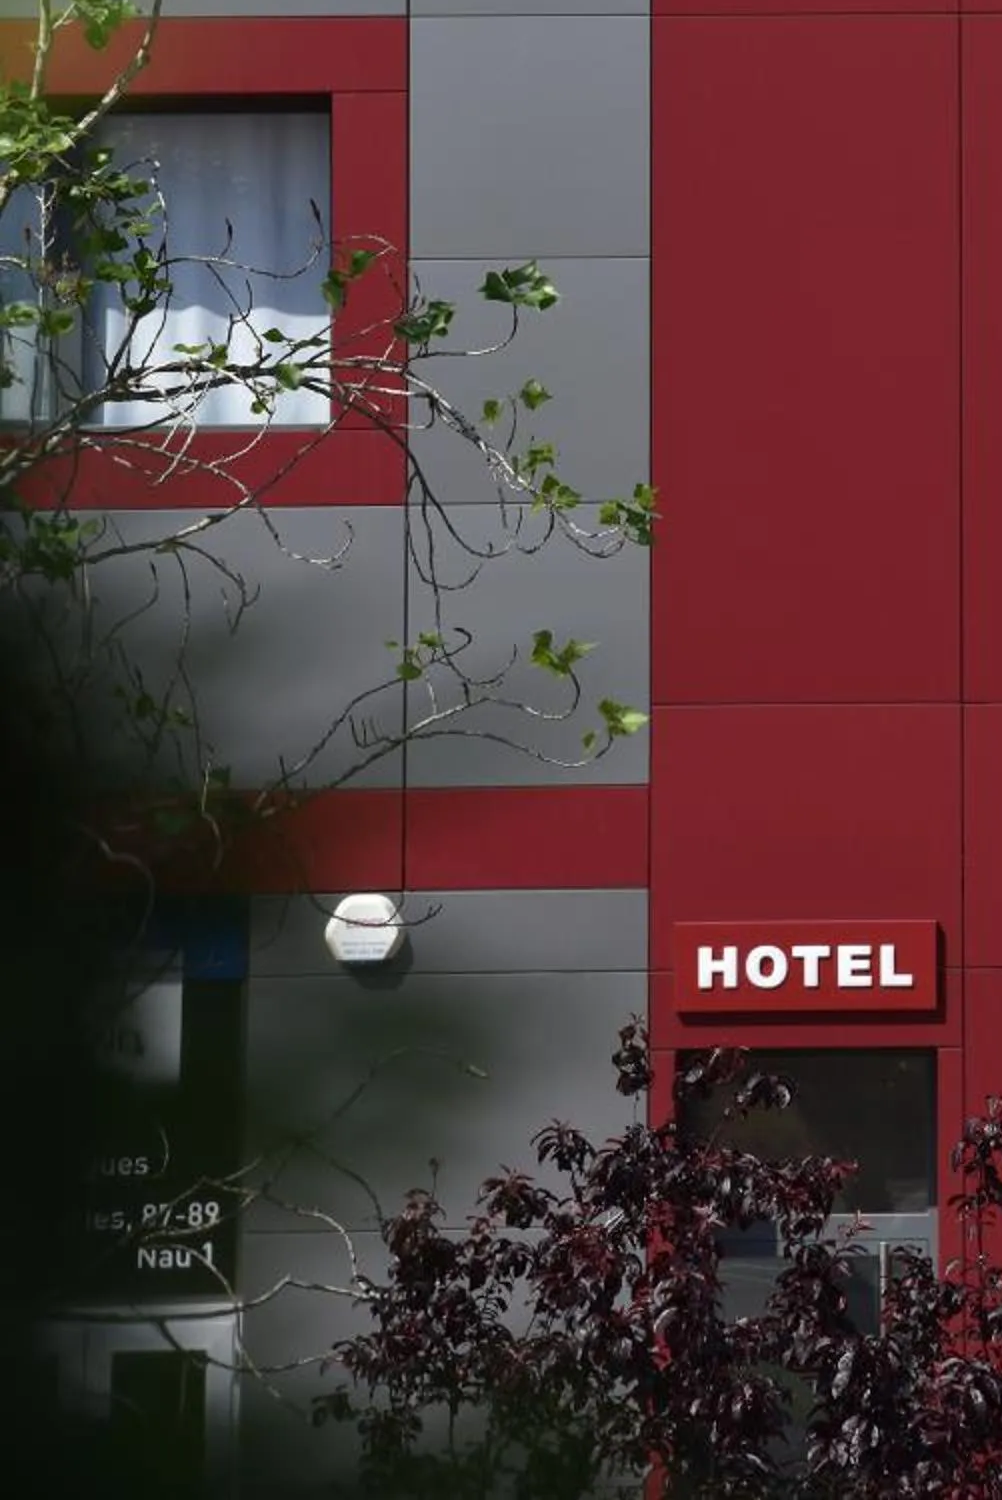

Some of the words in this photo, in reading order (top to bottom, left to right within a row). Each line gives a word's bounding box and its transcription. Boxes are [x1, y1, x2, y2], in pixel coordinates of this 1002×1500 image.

[697, 943, 914, 990] HOTEL
[141, 1201, 220, 1228] 87-89
[137, 1245, 193, 1269] Nau
[201, 1241, 214, 1267] 1
